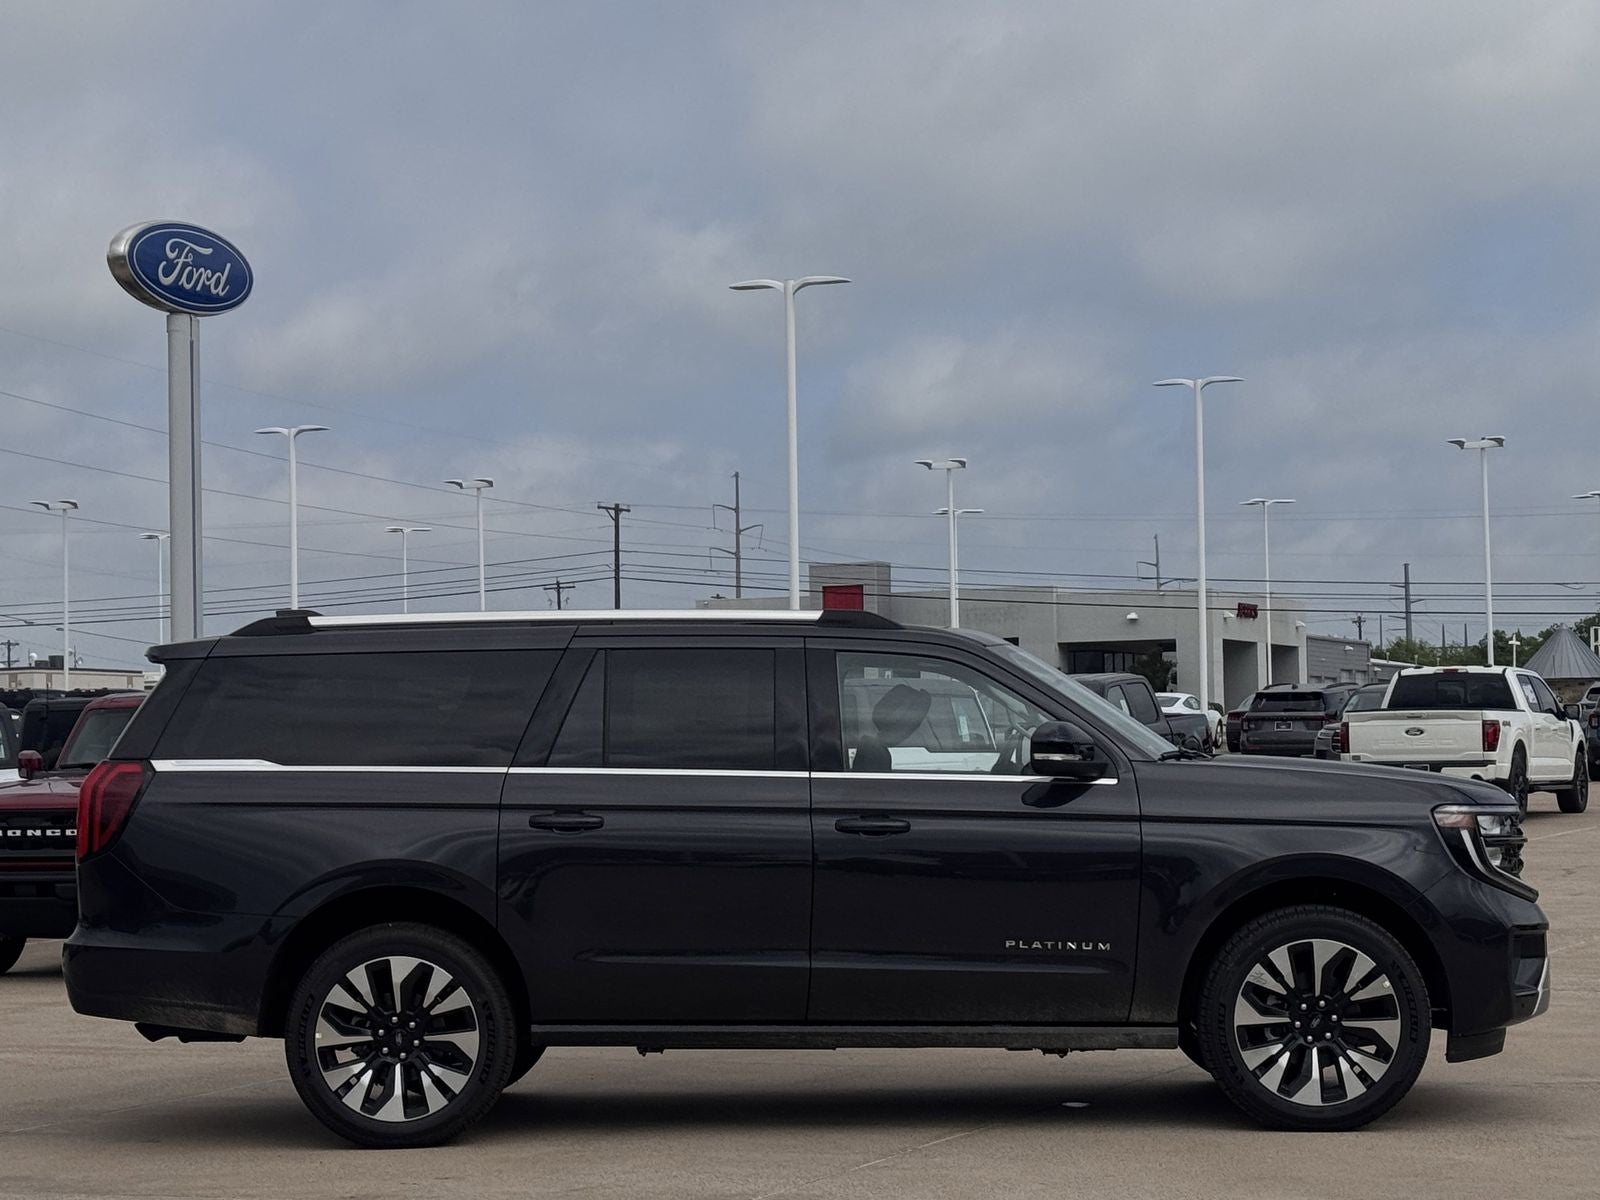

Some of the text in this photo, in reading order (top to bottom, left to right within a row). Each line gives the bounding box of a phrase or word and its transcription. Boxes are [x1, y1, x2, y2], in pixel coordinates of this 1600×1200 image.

[158, 238, 231, 296] Ford
[0, 829, 78, 837] ONCO
[1005, 940, 1111, 951] PLATINUM
